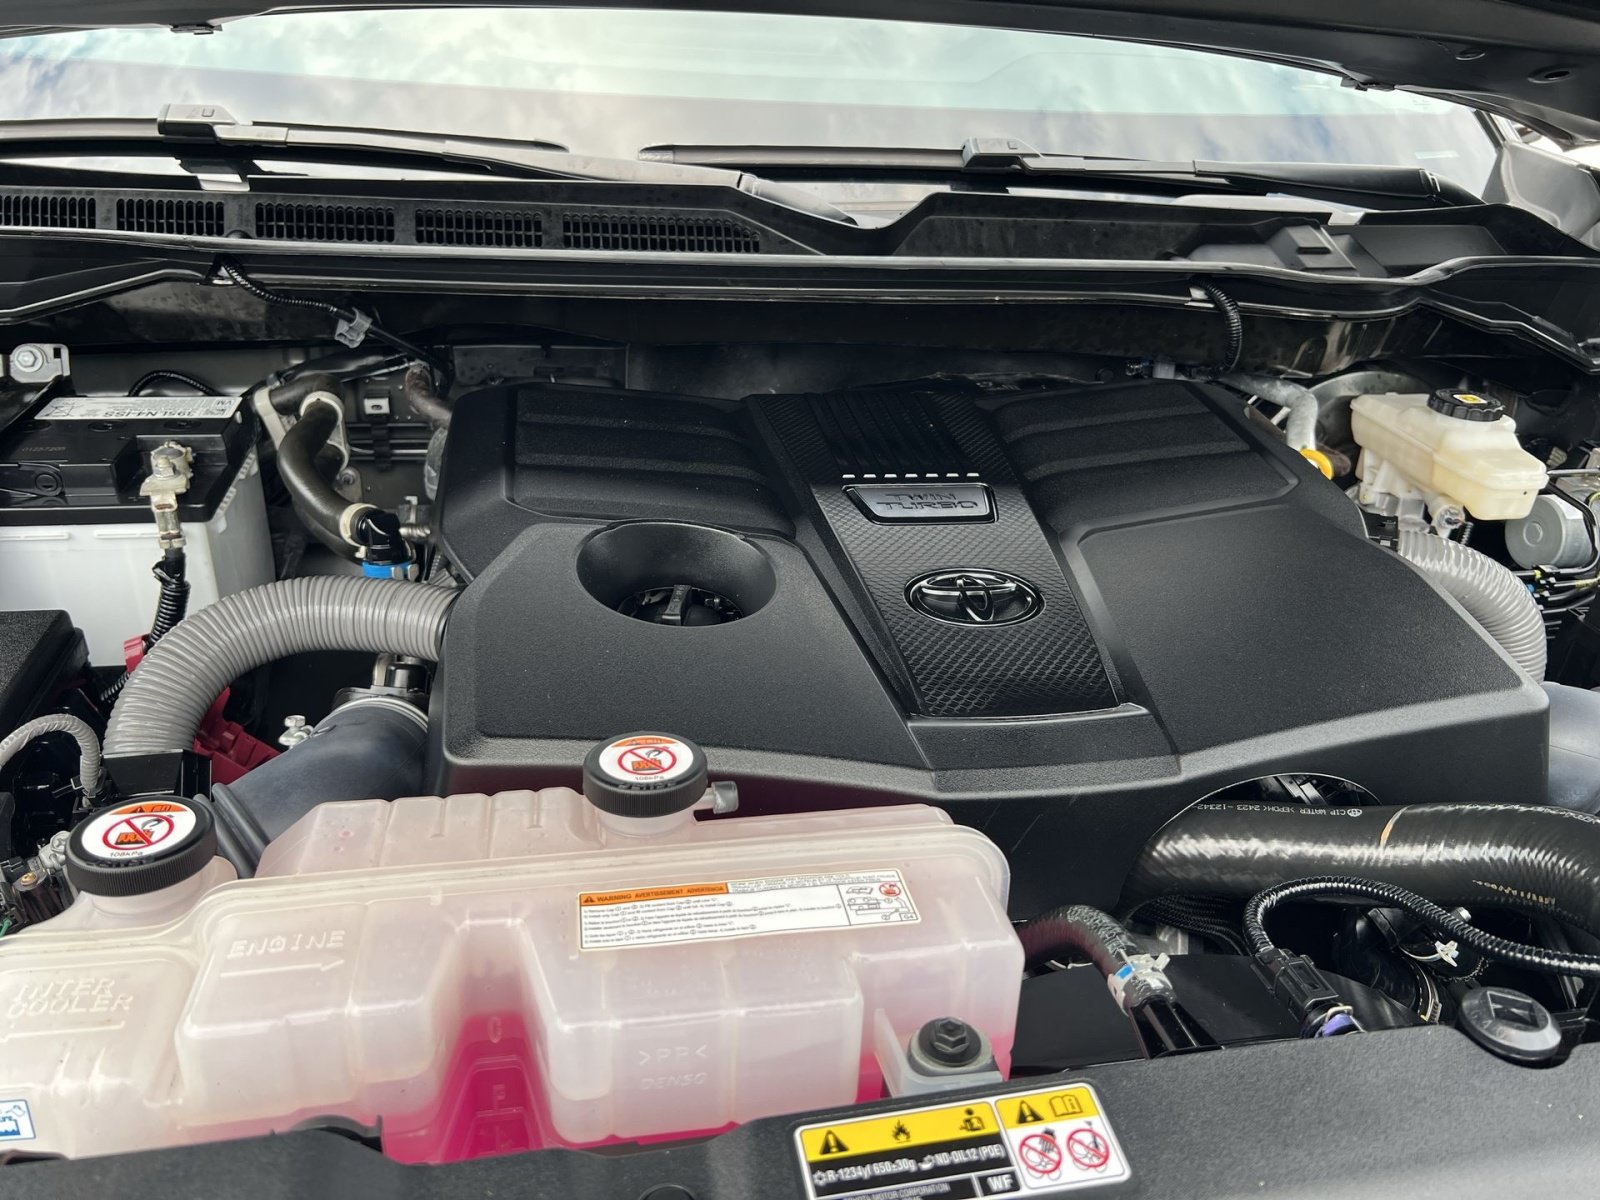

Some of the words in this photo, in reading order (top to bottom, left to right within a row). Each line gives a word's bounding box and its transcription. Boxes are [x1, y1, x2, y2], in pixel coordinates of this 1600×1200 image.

[876, 500, 978, 510] TURBO
[884, 493, 957, 501] TWIN
[1236, 803, 1261, 811] 2423
[1300, 807, 1327, 815] WATER
[596, 893, 632, 902] WARNING
[634, 888, 684, 899] AVERTISSEMENT
[686, 885, 724, 894] ADVERTENCIA
[227, 930, 346, 960] ENGINE
[17, 977, 117, 1001] INTER
[5, 994, 134, 1019] COOLER
[640, 1072, 707, 1090] DENSO
[826, 1164, 873, 1181] R-1234yf
[873, 1158, 917, 1175] 650±30g
[934, 1150, 978, 1166] ND-OIL12
[899, 1182, 952, 1198] CORPORATION
[986, 1174, 1014, 1191] WF
